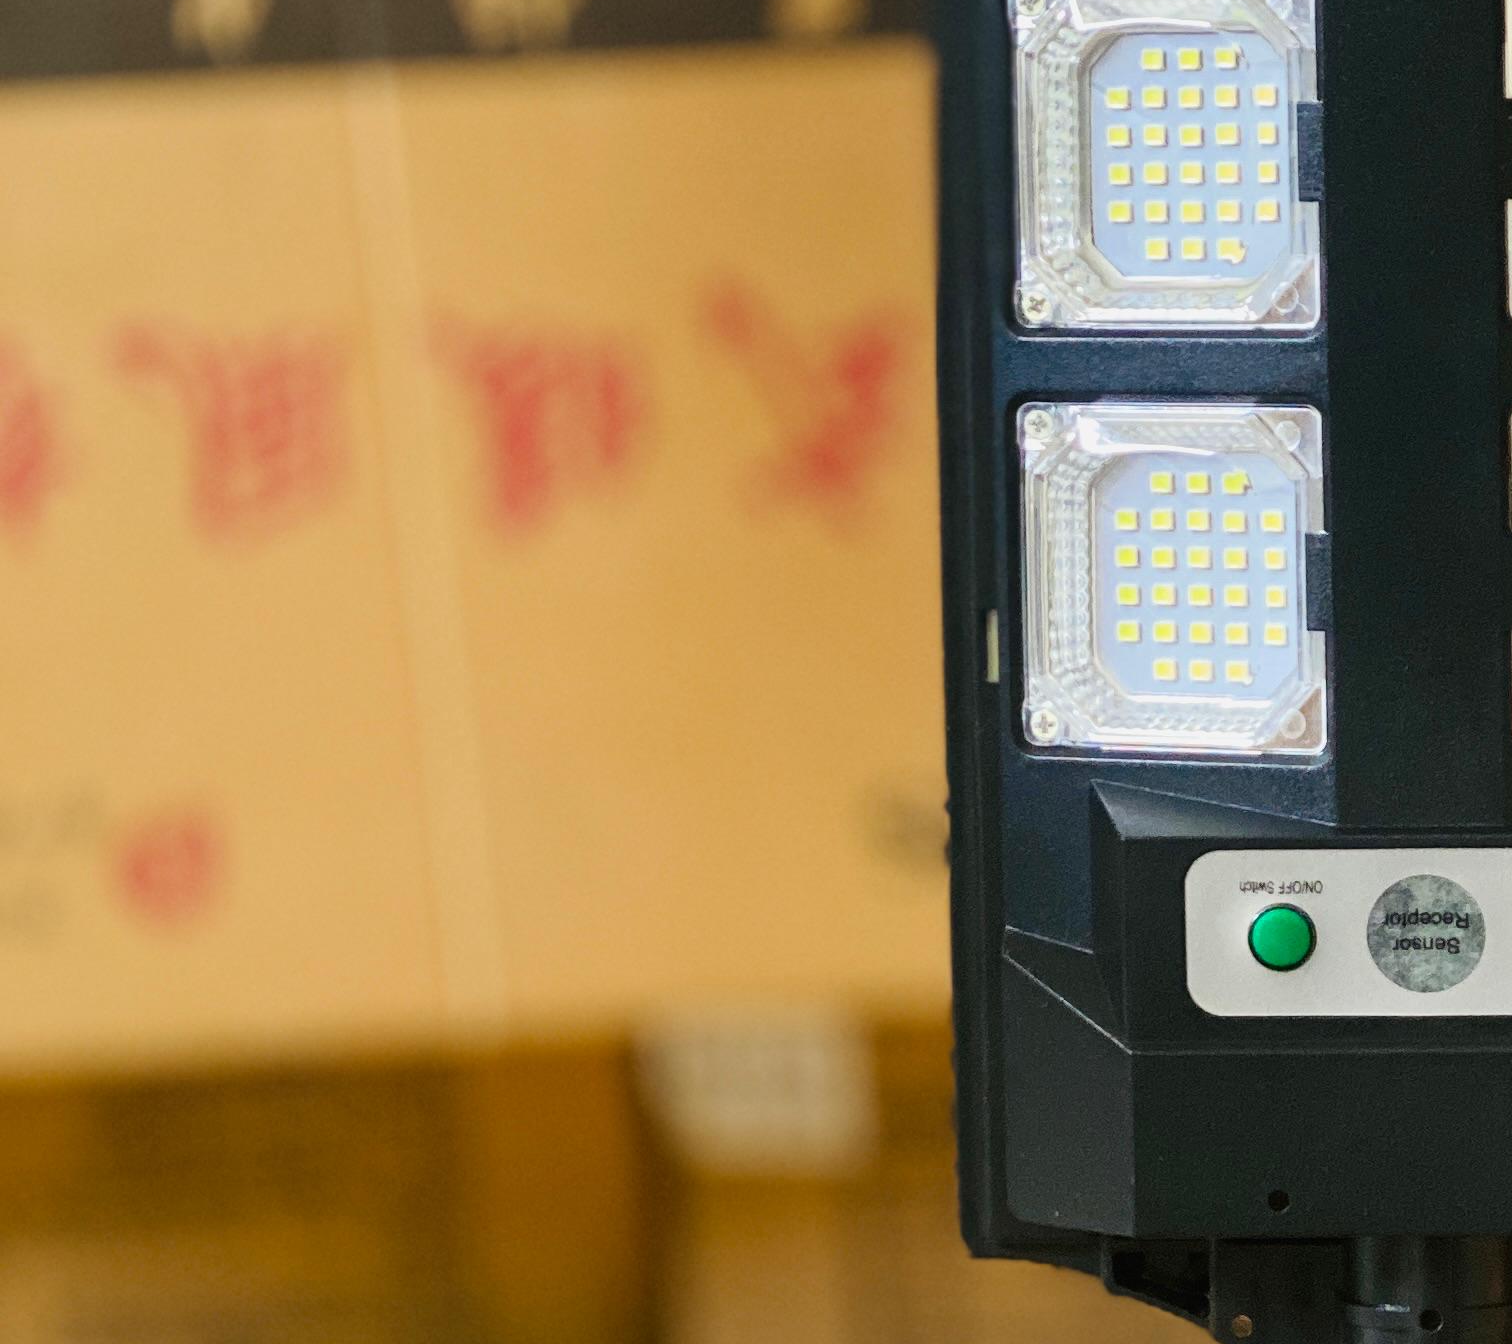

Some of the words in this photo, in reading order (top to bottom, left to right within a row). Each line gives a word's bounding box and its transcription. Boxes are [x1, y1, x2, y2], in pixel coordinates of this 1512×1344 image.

[1239, 880, 1275, 895] Switch
[1278, 880, 1324, 895] ON/OFF
[1383, 908, 1470, 929] Receptor
[1392, 936, 1460, 954] Sensor
